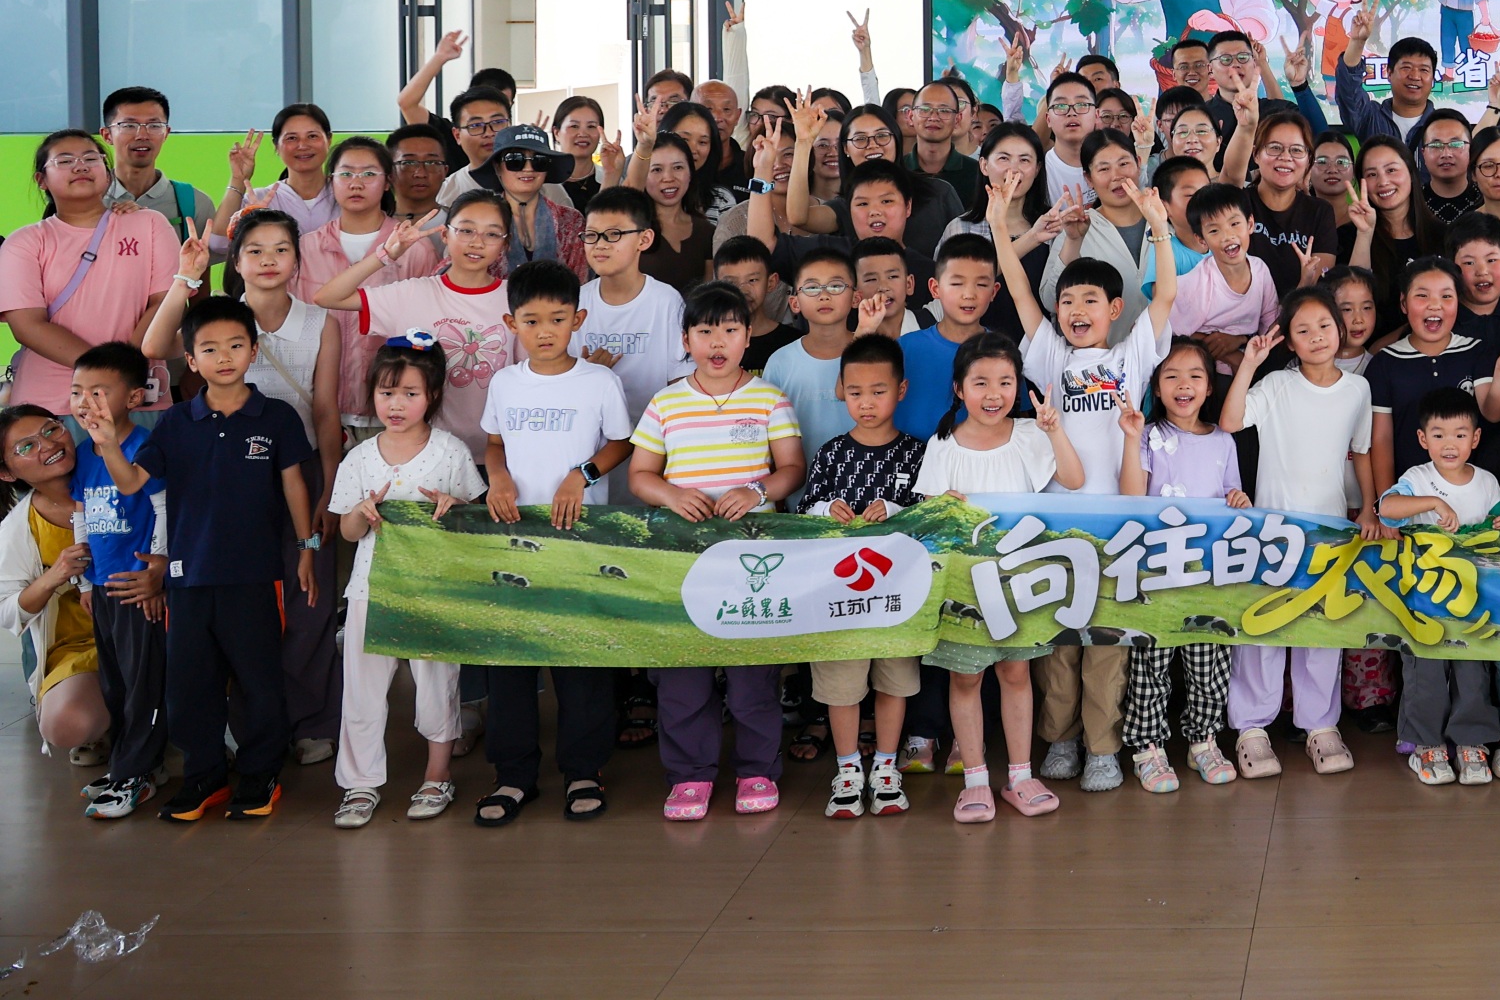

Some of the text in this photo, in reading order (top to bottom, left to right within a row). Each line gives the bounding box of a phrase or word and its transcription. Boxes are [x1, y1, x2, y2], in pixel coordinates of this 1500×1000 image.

[118, 237, 139, 256] NY
[585, 332, 649, 355] SPORT
[1063, 392, 1127, 413] CONVER
[505, 407, 577, 431] SPORT
[970, 506, 1478, 645] 向往的农场
[828, 593, 902, 618] 江苏广播
